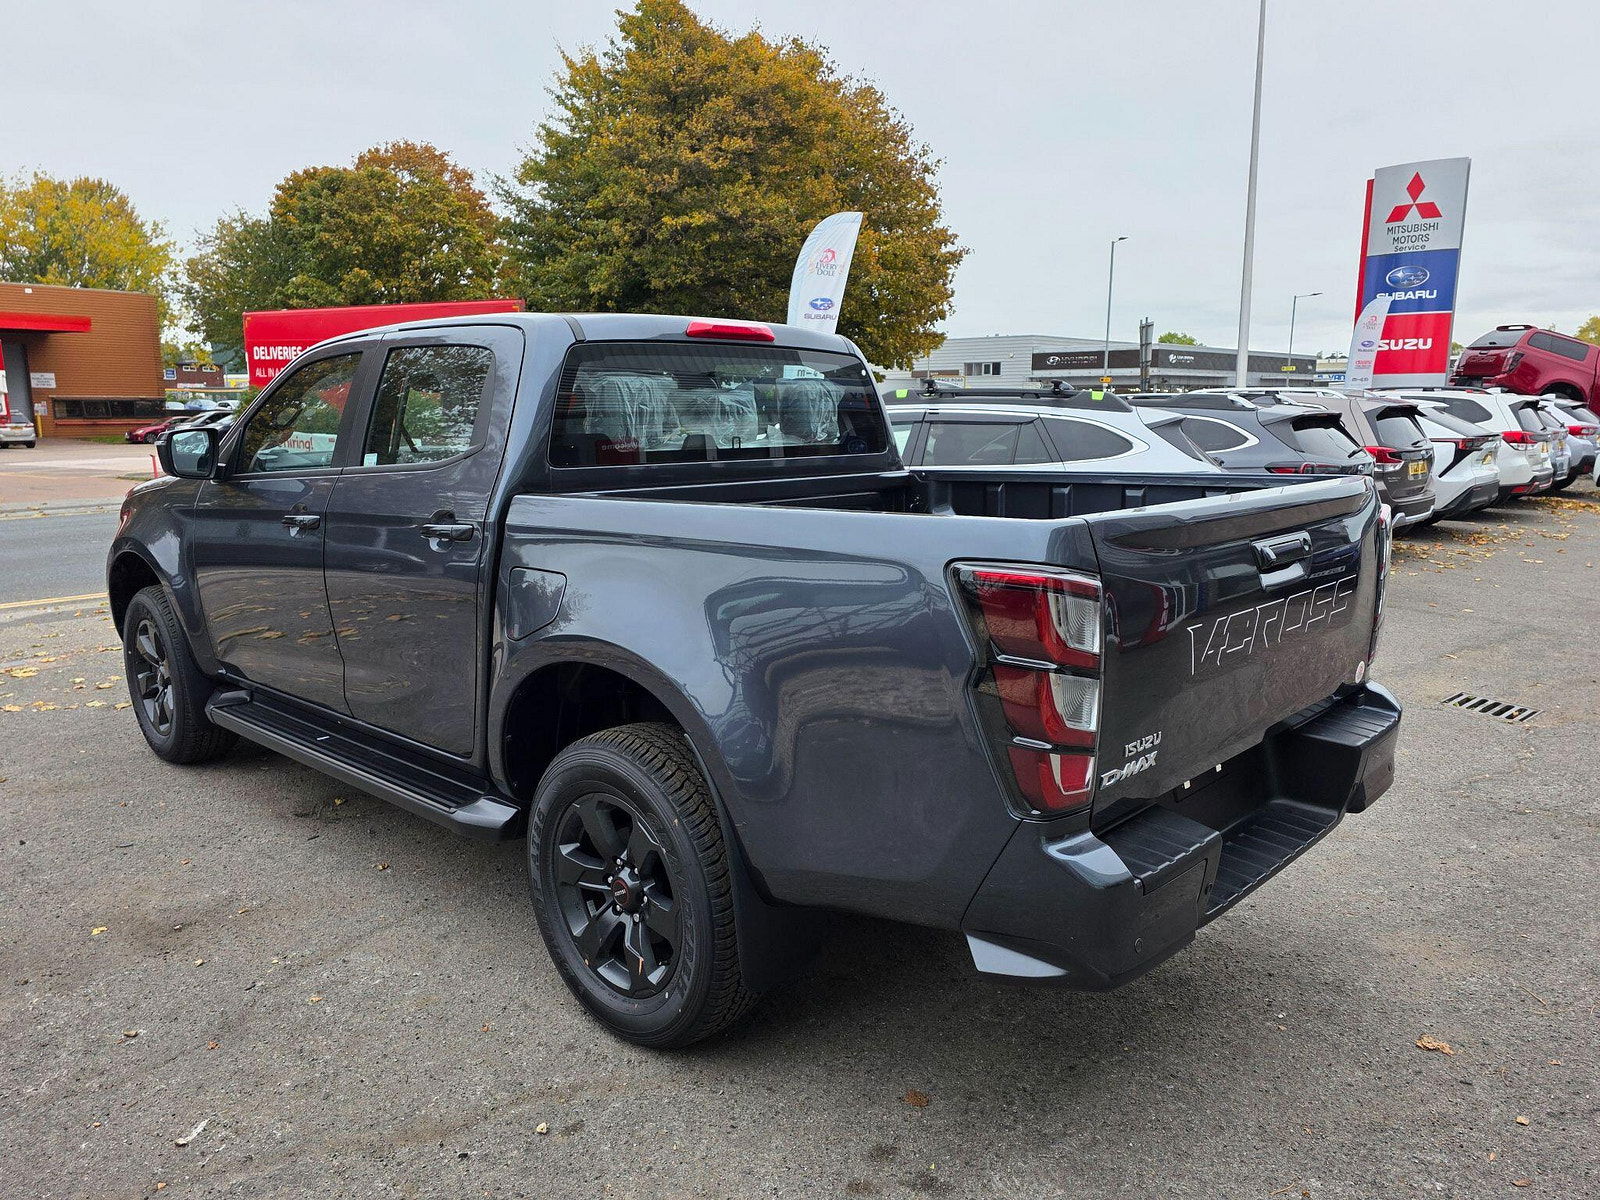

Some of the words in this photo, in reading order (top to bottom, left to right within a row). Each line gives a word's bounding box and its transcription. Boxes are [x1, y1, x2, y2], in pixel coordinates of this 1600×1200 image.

[1386, 222, 1439, 235] MITSUBISHI
[1392, 234, 1430, 245] MOTORS
[1394, 244, 1426, 252] Service
[1376, 337, 1433, 351] SUZU
[253, 345, 303, 360] DELIVERIES
[255, 367, 268, 377] ALL
[267, 367, 275, 377] IN
[1125, 731, 1162, 757] ISUZU
